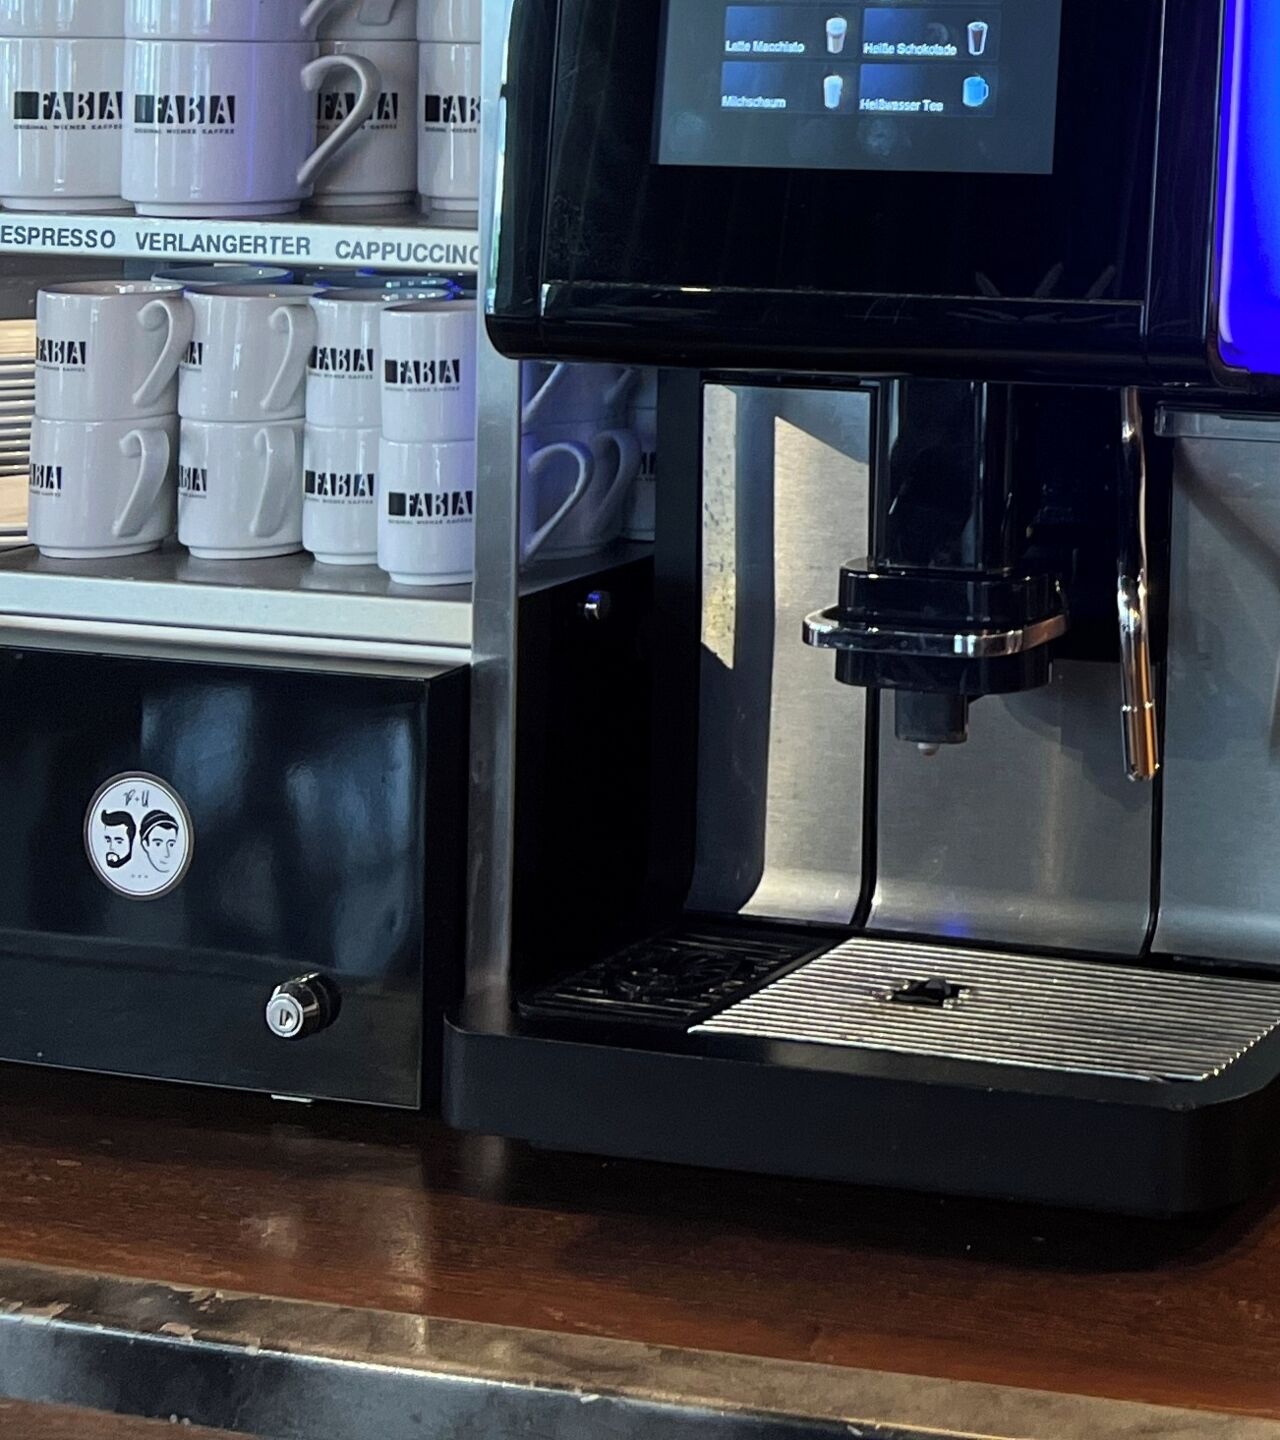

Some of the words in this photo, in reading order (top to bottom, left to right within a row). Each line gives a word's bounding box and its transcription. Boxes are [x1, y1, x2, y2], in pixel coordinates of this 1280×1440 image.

[41, 91, 123, 121] FABIA
[156, 94, 236, 125] FABIA
[0, 225, 116, 249] ESPRESSO
[136, 231, 311, 256] VERLANGERTER
[318, 347, 374, 372] FABIA
[400, 359, 460, 385] FABIA
[317, 472, 375, 497] FABIA
[408, 490, 473, 518] FABIA
